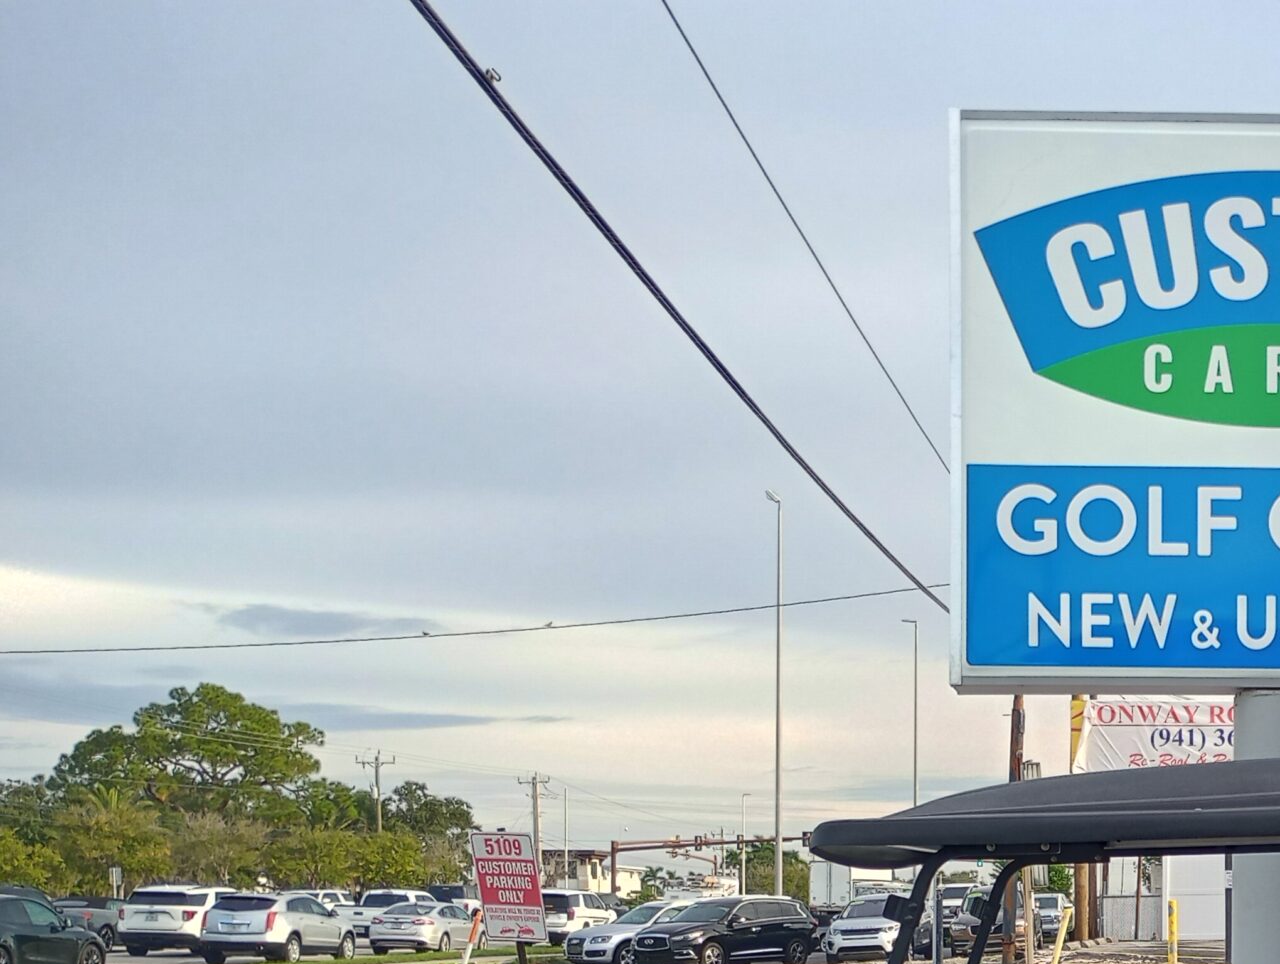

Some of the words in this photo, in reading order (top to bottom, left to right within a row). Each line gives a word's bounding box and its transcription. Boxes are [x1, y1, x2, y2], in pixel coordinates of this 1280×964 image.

[995, 483, 1243, 557] GOLF
[1027, 591, 1178, 649] NEW
[1190, 609, 1221, 650] &
[1091, 704, 1199, 724] ONWAY
[1150, 727, 1206, 751] (941)
[483, 838, 522, 856] 5109
[478, 861, 535, 876] CUSTOMER
[485, 876, 532, 889] PARKING
[498, 889, 525, 904] ONLY
